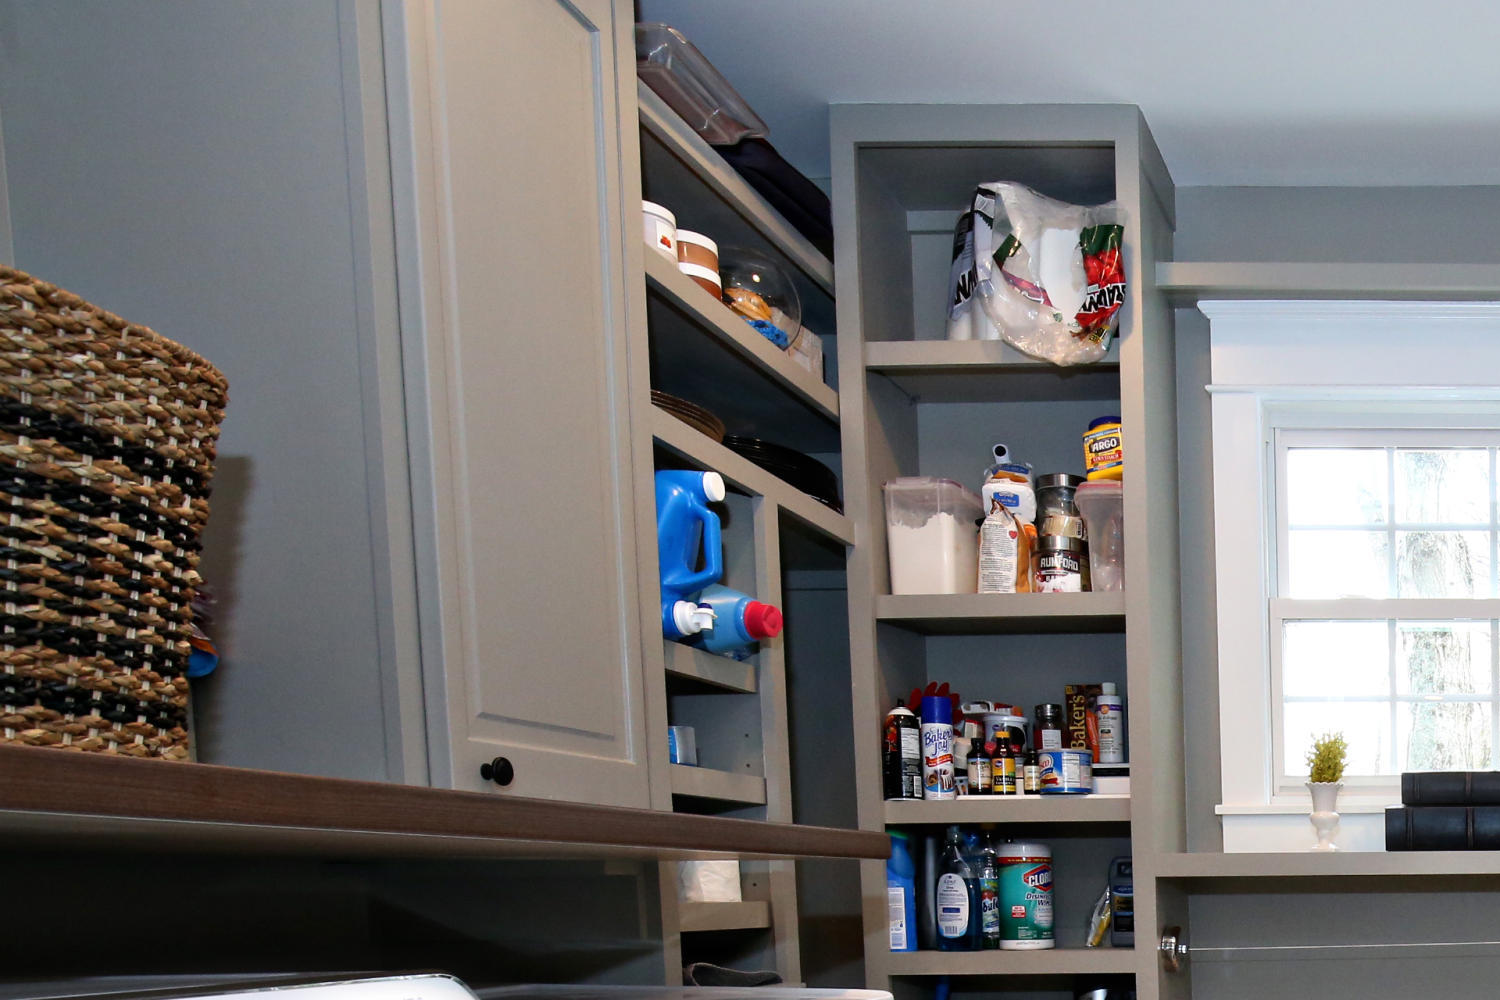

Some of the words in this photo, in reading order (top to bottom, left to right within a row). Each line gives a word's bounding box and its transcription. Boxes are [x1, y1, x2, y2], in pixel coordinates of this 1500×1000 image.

[1092, 438, 1118, 453] ARGO
[1040, 555, 1079, 571] RUMFORD
[1069, 695, 1087, 750] Baker's
[932, 740, 949, 757] Joy
